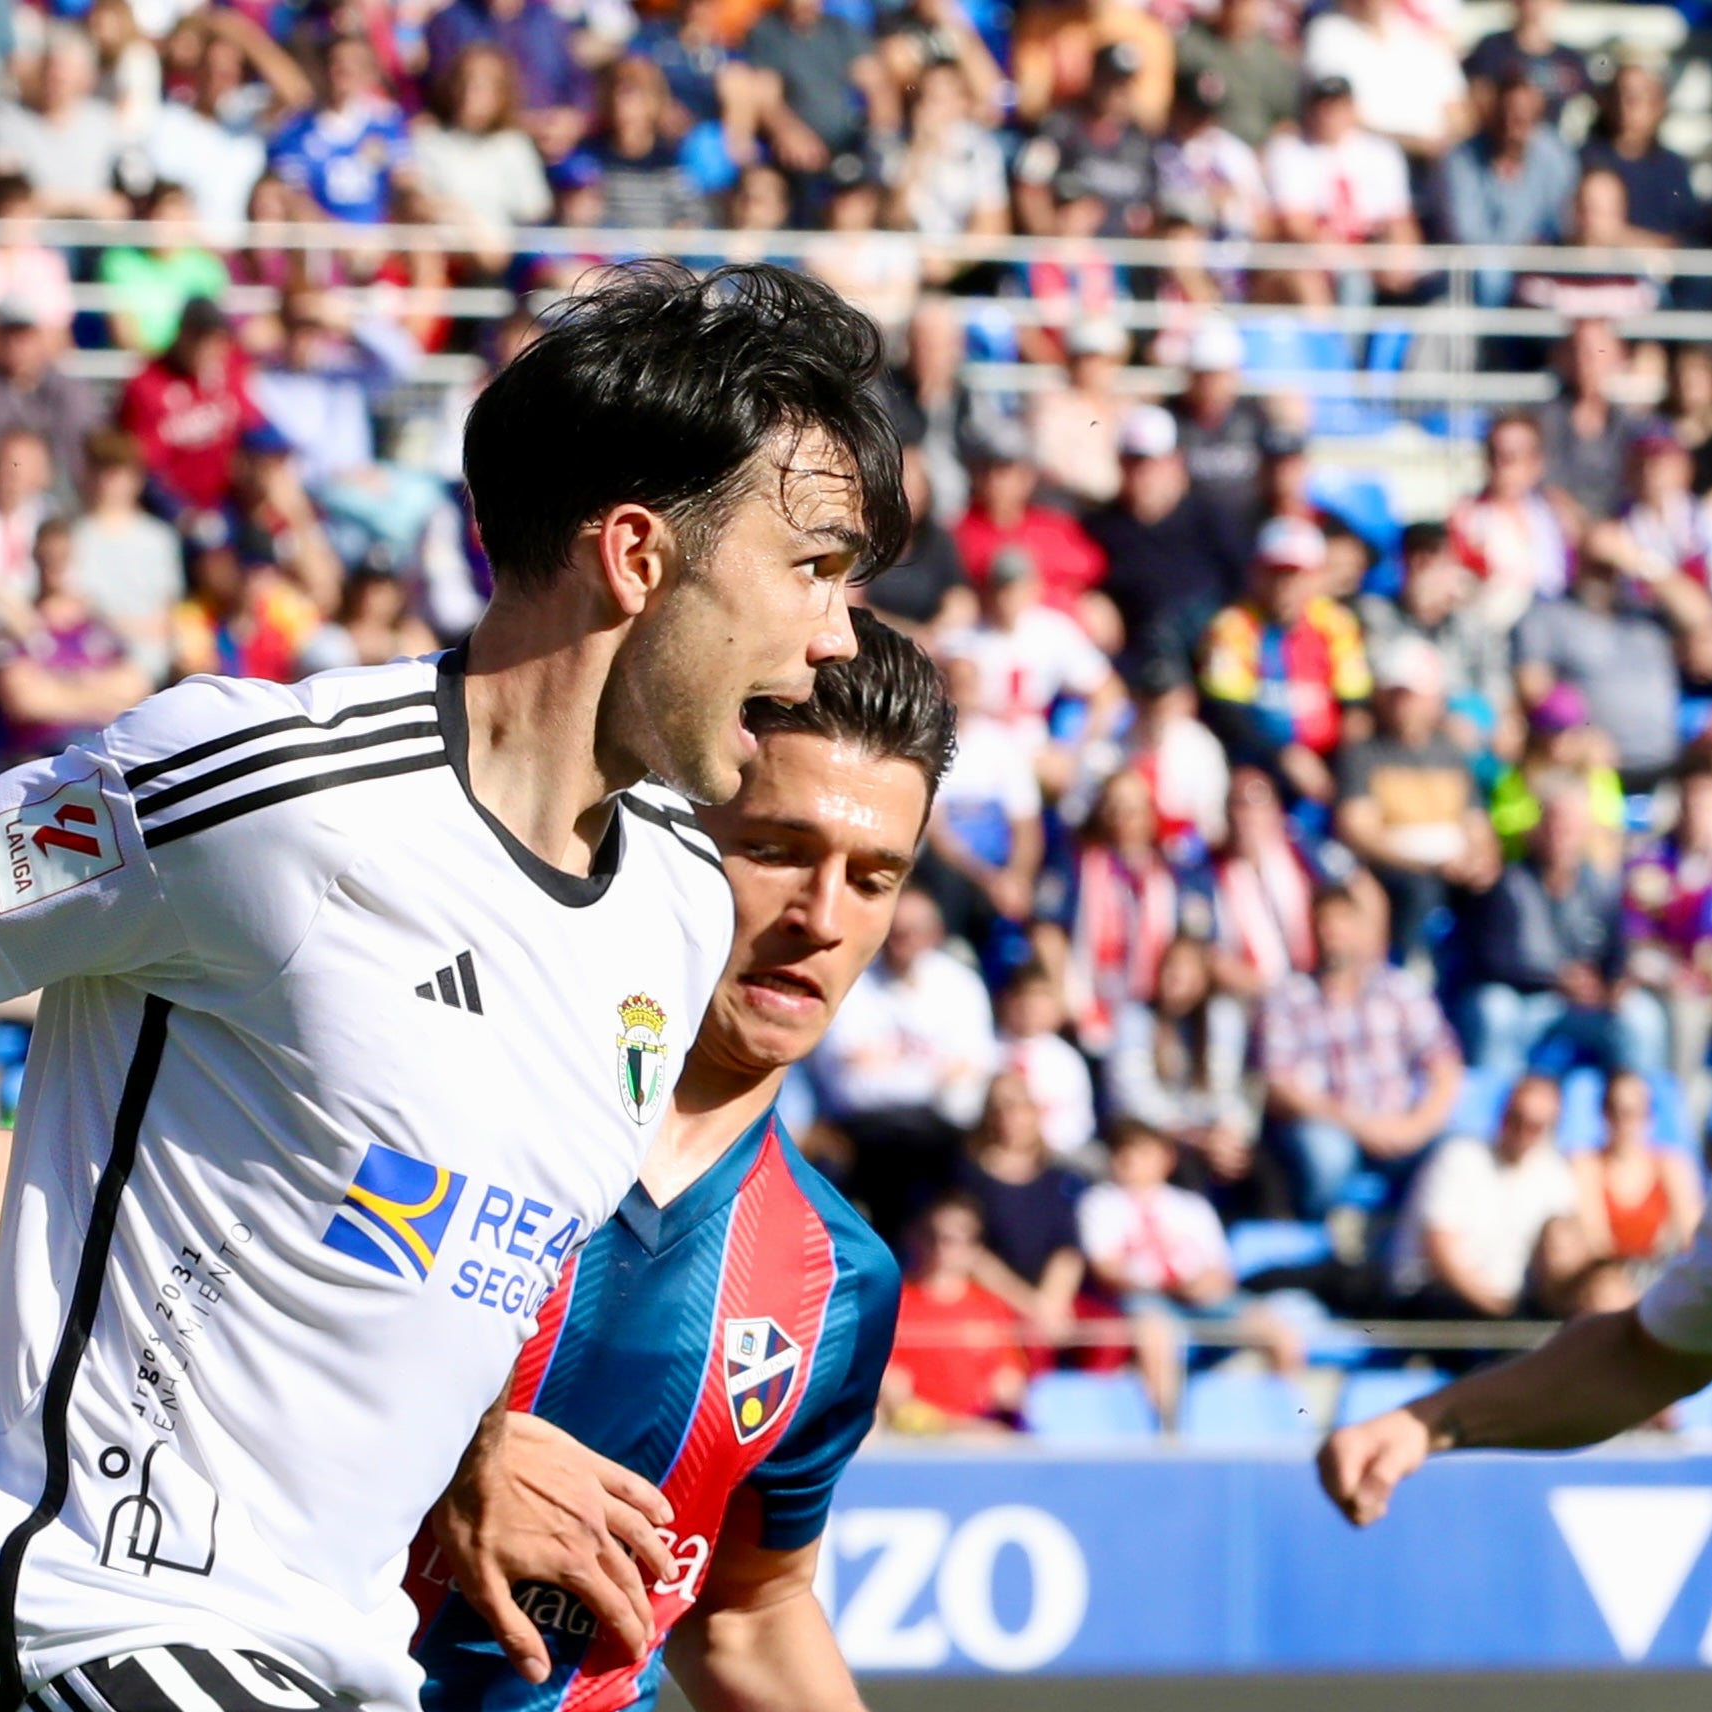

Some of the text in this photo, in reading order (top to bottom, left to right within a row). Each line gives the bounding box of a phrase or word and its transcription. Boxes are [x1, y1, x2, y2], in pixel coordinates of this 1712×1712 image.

[5, 818, 33, 895] LALIGA
[470, 1184, 581, 1271] REA
[156, 1246, 202, 1322] 2031
[451, 1260, 556, 1319] SEGU
[811, 1503, 1090, 1673] ZO
